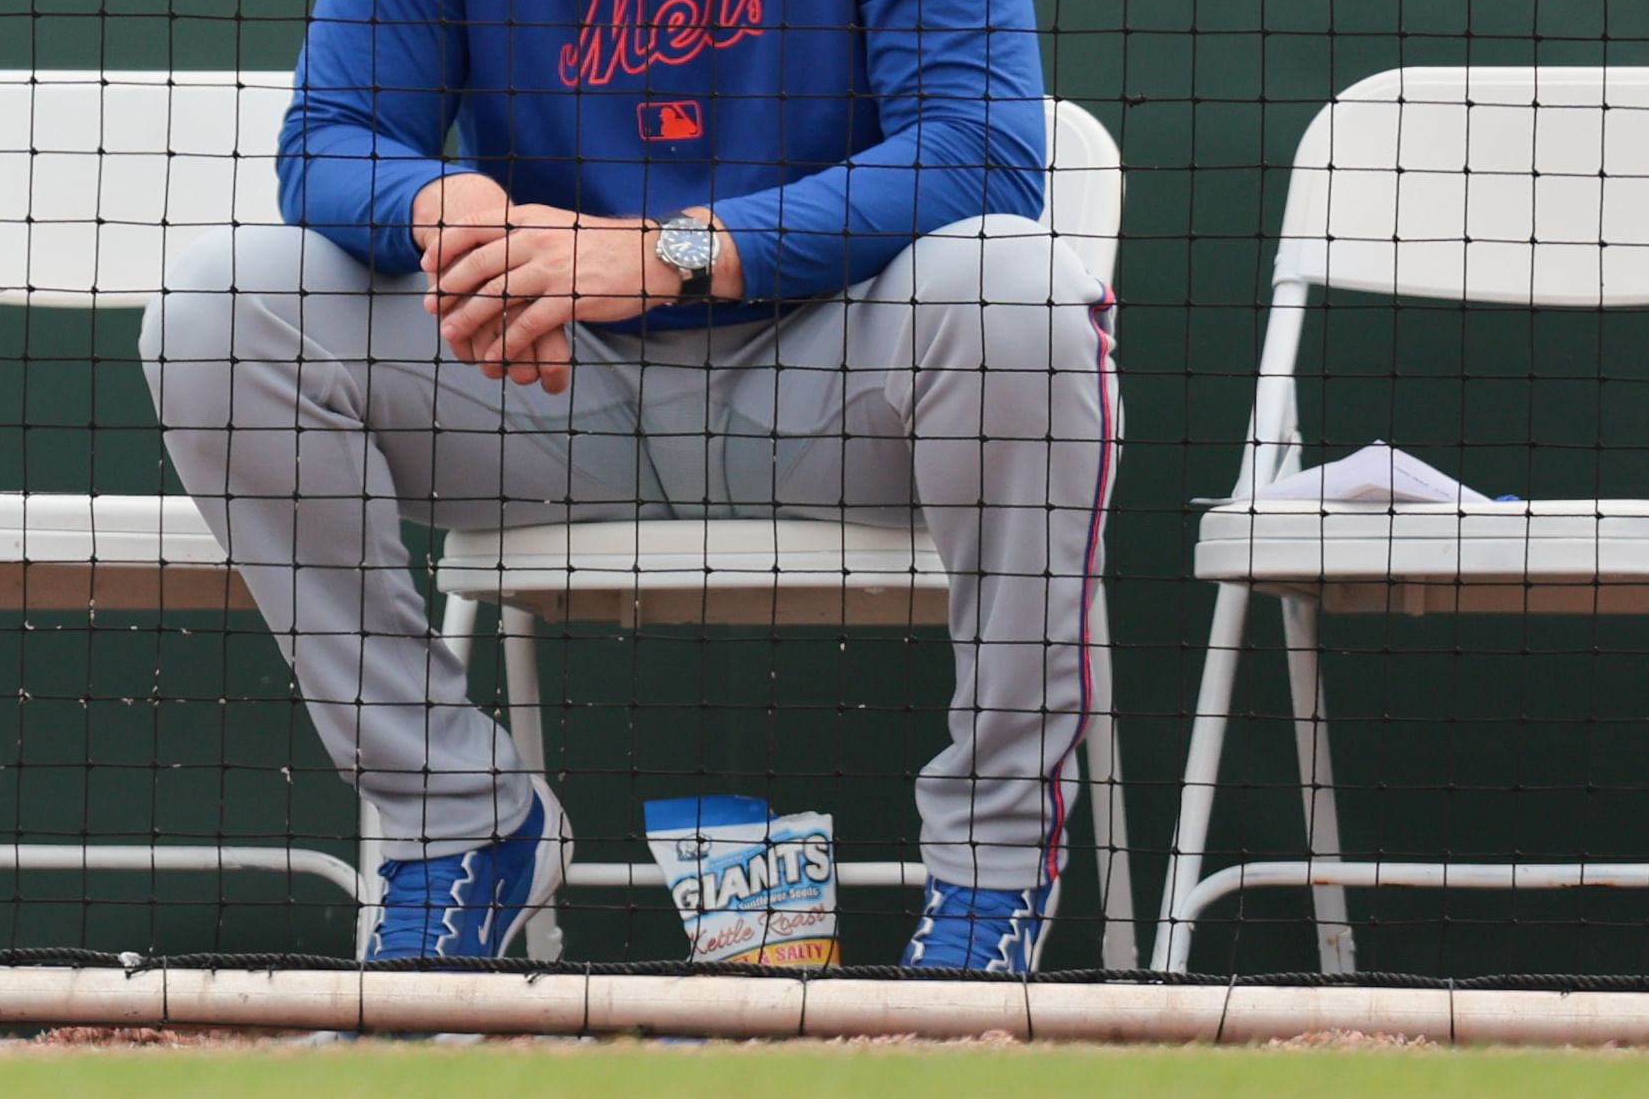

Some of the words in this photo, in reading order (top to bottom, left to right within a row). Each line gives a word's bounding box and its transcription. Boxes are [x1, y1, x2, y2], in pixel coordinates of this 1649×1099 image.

[671, 833, 830, 920] GIANTS
[690, 916, 755, 955] Kettle
[758, 904, 826, 937] Roast
[774, 942, 823, 962] SALTY
